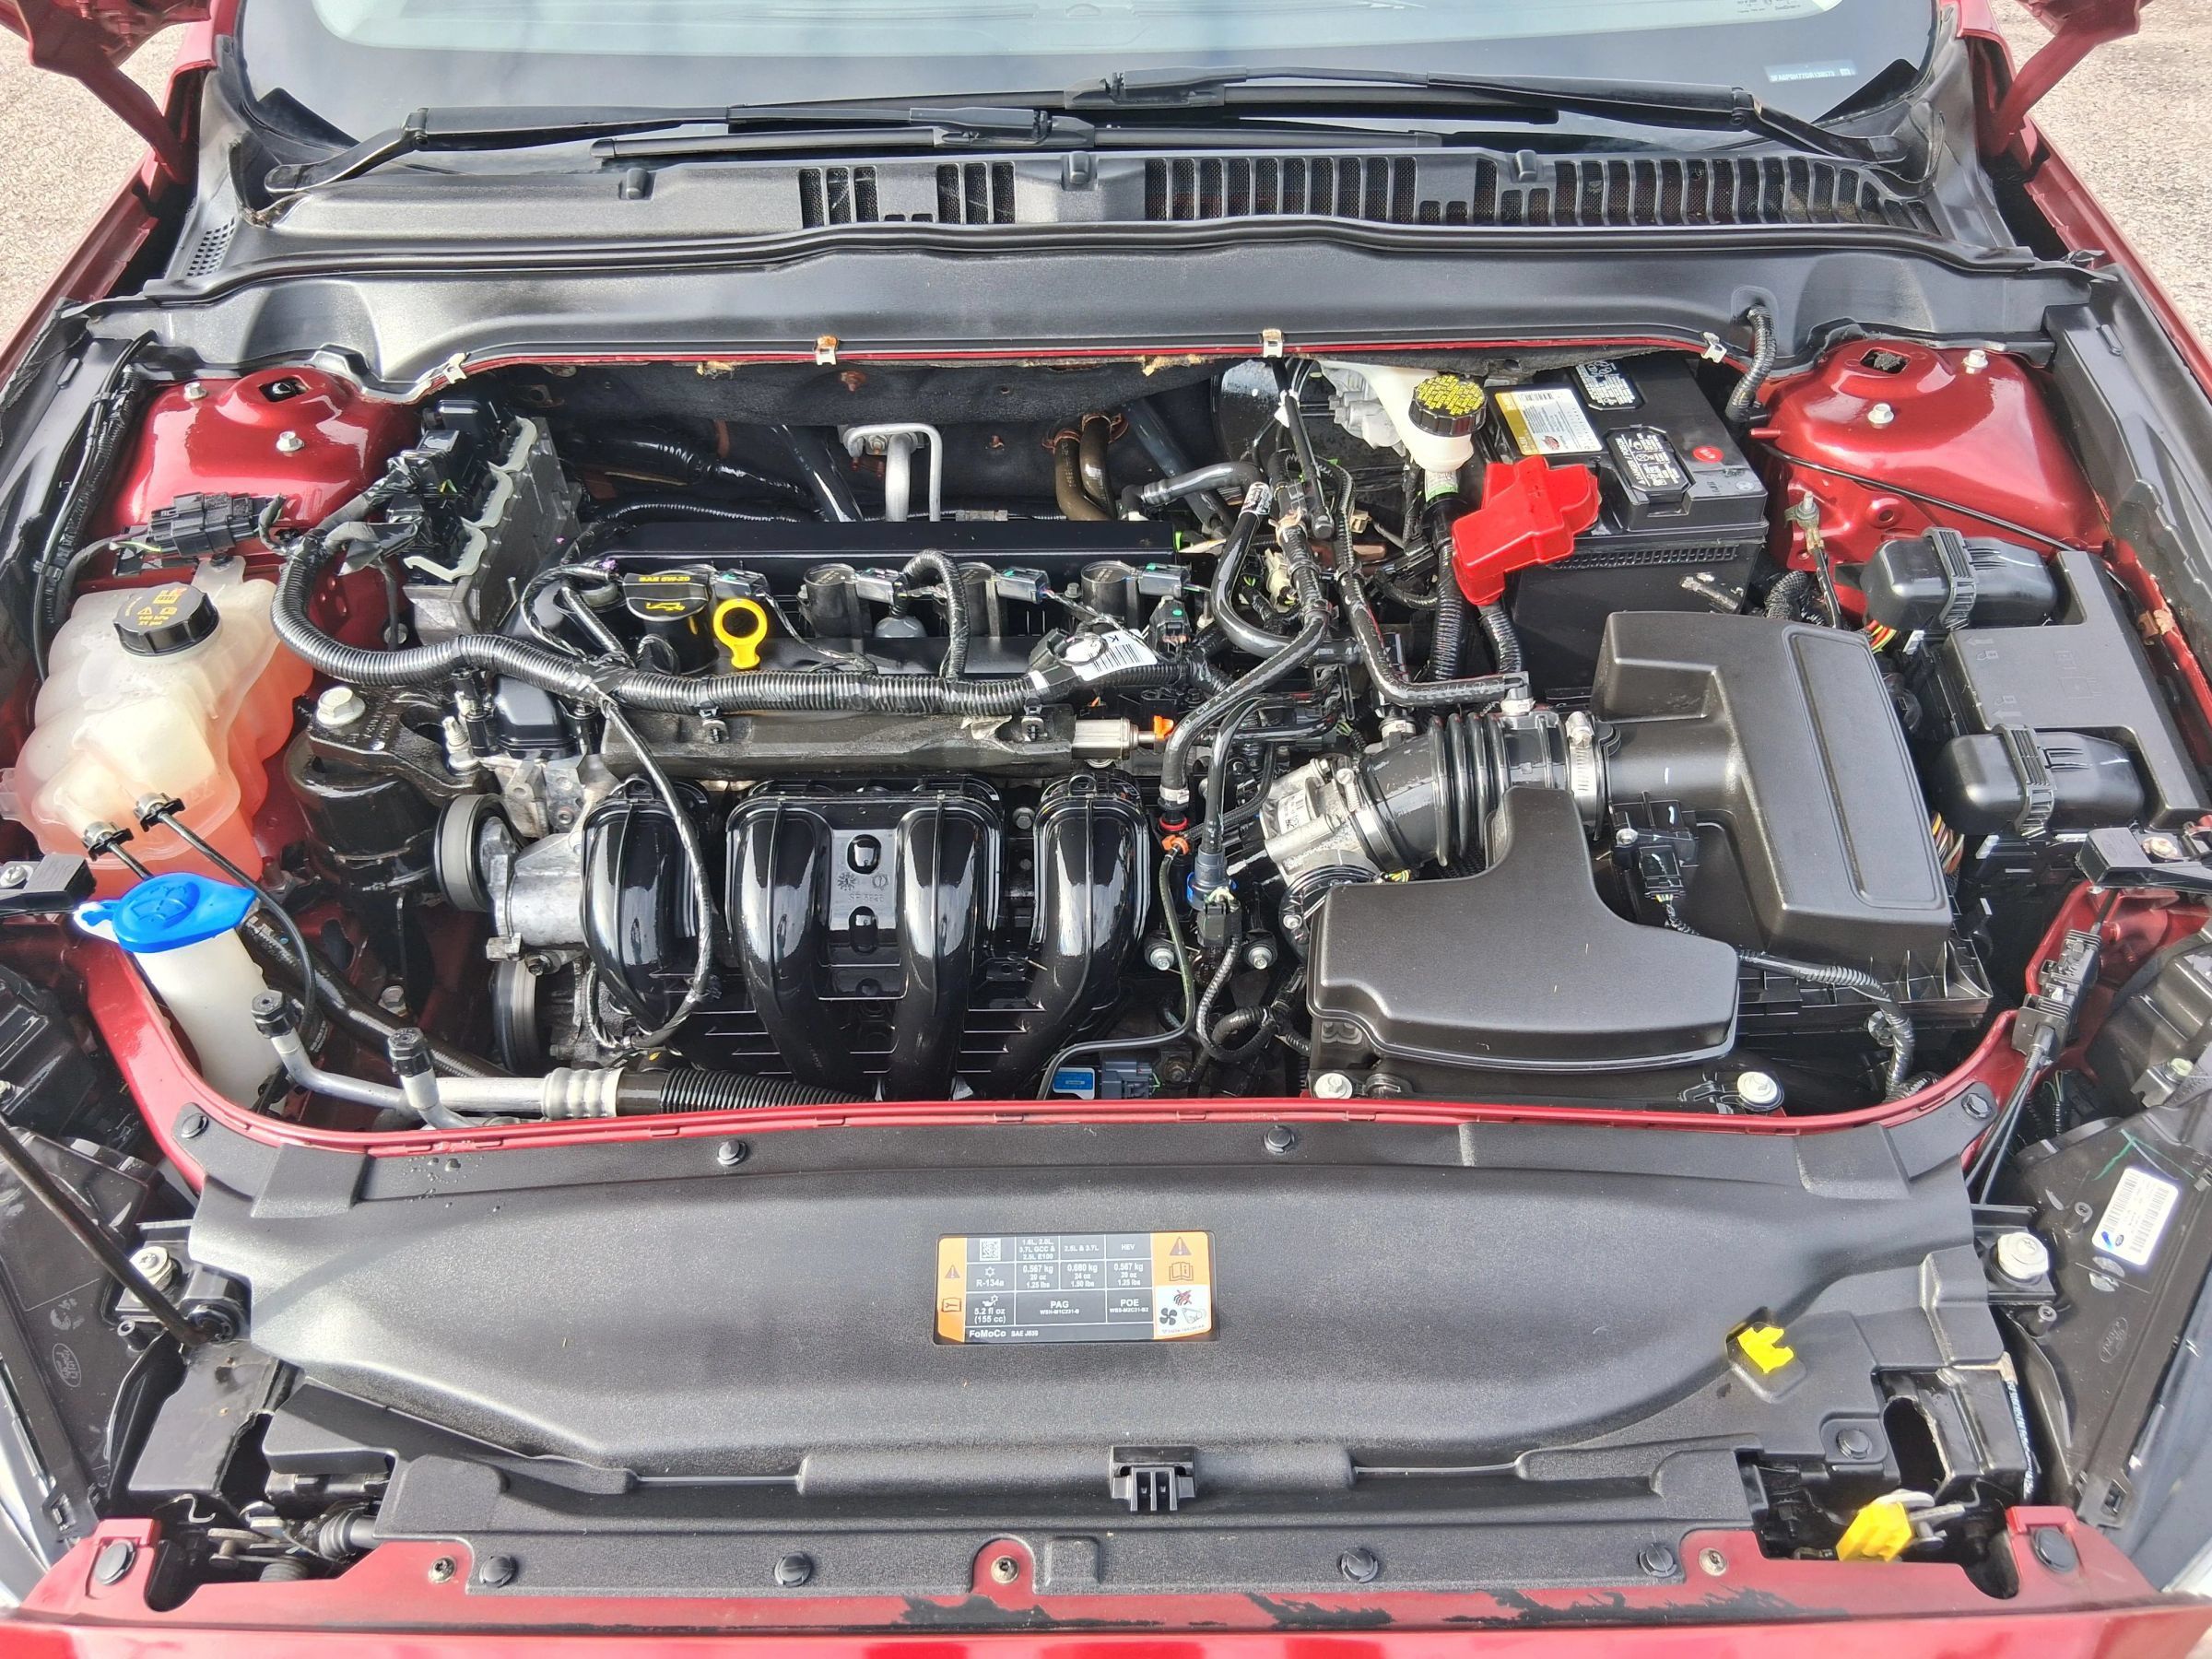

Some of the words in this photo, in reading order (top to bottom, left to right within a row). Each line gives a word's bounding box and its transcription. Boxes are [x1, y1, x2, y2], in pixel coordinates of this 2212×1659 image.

[1023, 1265, 1042, 1273] 0.567
[1044, 1264, 1053, 1274] kg
[1067, 1264, 1087, 1272] 0.680
[1088, 1263, 1098, 1273] kg
[1113, 1263, 1133, 1271] 0.567
[1135, 1263, 1144, 1272] kg
[976, 1279, 1005, 1288] R-134a
[1050, 1300, 1069, 1309] PAG
[1120, 1299, 1139, 1307] POE
[987, 1307, 994, 1315] fl
[974, 1315, 992, 1324] (155
[994, 1315, 1006, 1324] cc)
[969, 1329, 1006, 1337] FoMoCo
